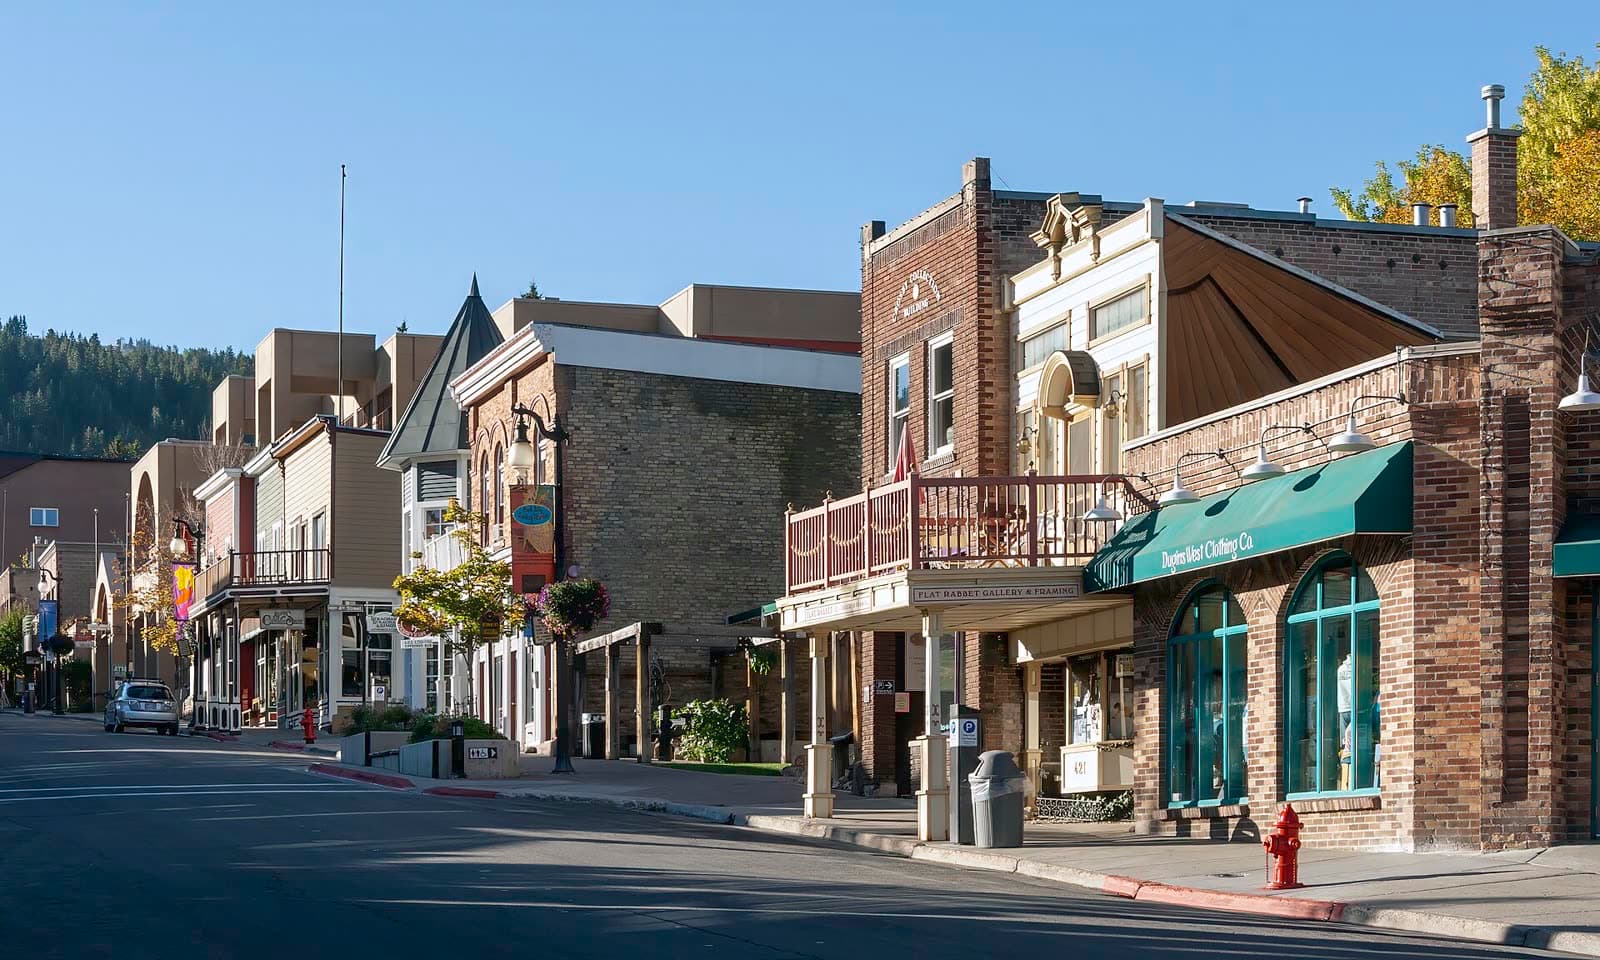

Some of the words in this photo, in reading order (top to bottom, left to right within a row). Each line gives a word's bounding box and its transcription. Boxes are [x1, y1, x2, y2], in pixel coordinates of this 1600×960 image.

[909, 270, 941, 302] COLLECTION
[903, 297, 929, 318] BUILDING
[1161, 549, 1186, 574] Dugins
[1185, 543, 1204, 563] West
[1204, 537, 1239, 560] Clothing
[917, 590, 941, 600] FLAT
[943, 589, 980, 599] RABBET
[982, 588, 1024, 598] GALLERY
[1034, 586, 1075, 596] FRAMING
[1073, 760, 1087, 776] 421
